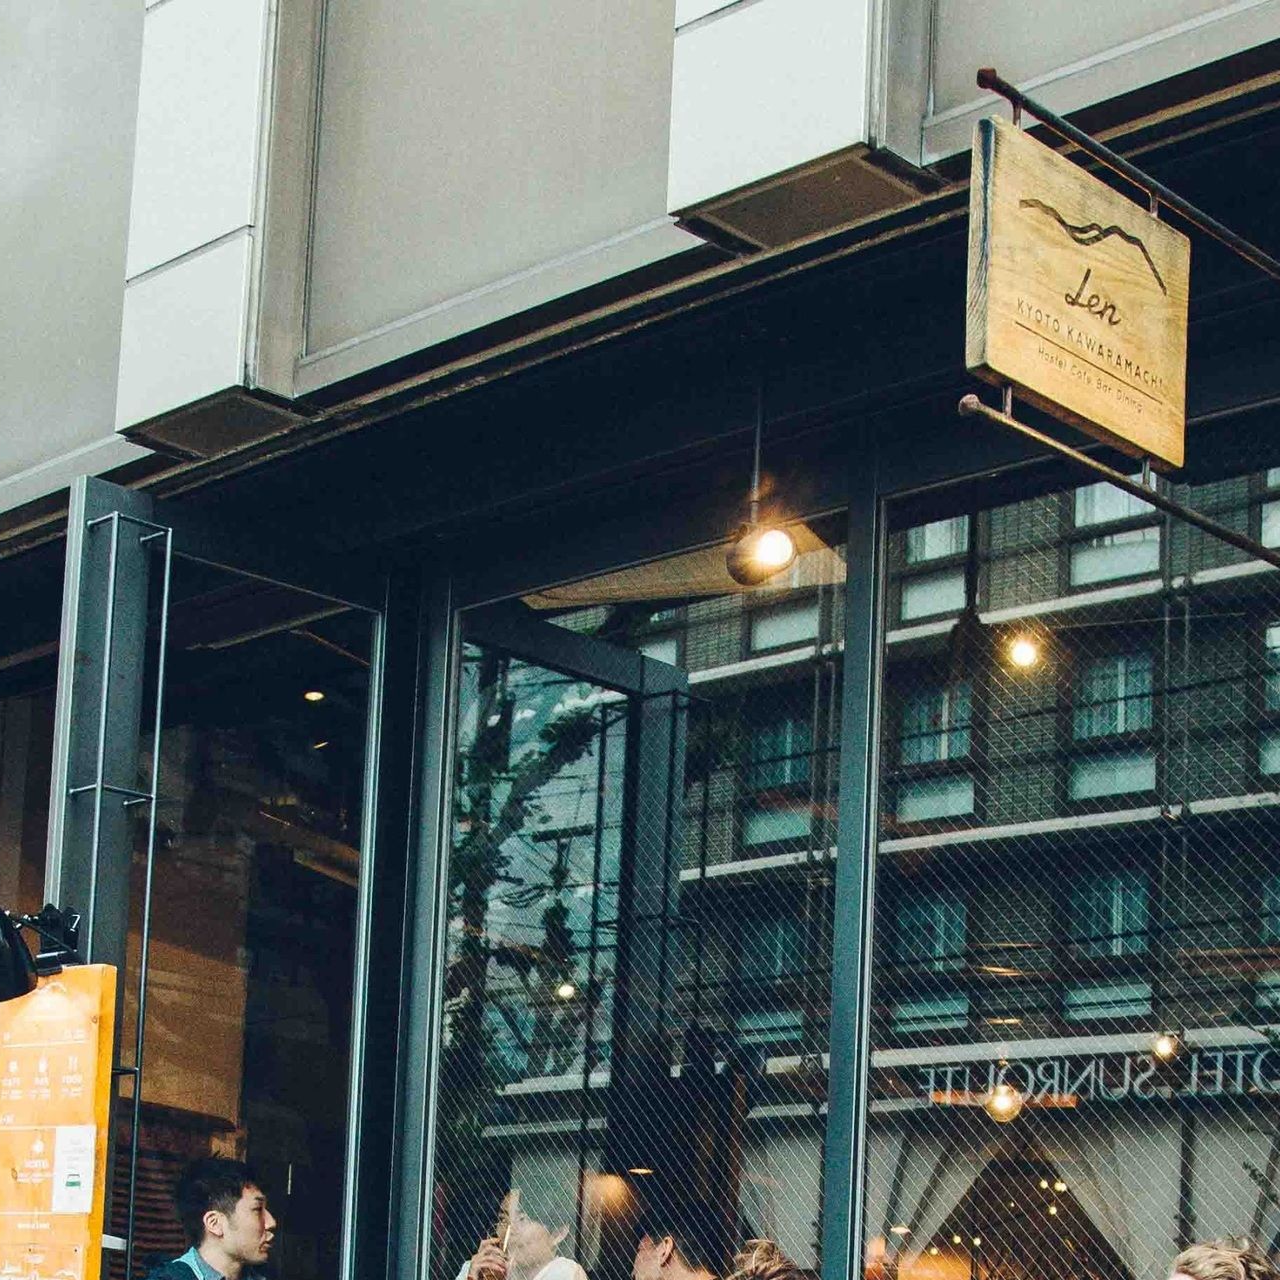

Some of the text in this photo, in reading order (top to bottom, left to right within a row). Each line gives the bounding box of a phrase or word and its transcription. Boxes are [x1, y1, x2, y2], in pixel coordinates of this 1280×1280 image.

[1065, 268, 1122, 325] Len
[1017, 297, 1164, 389] KYOTO KAWARAMACHI
